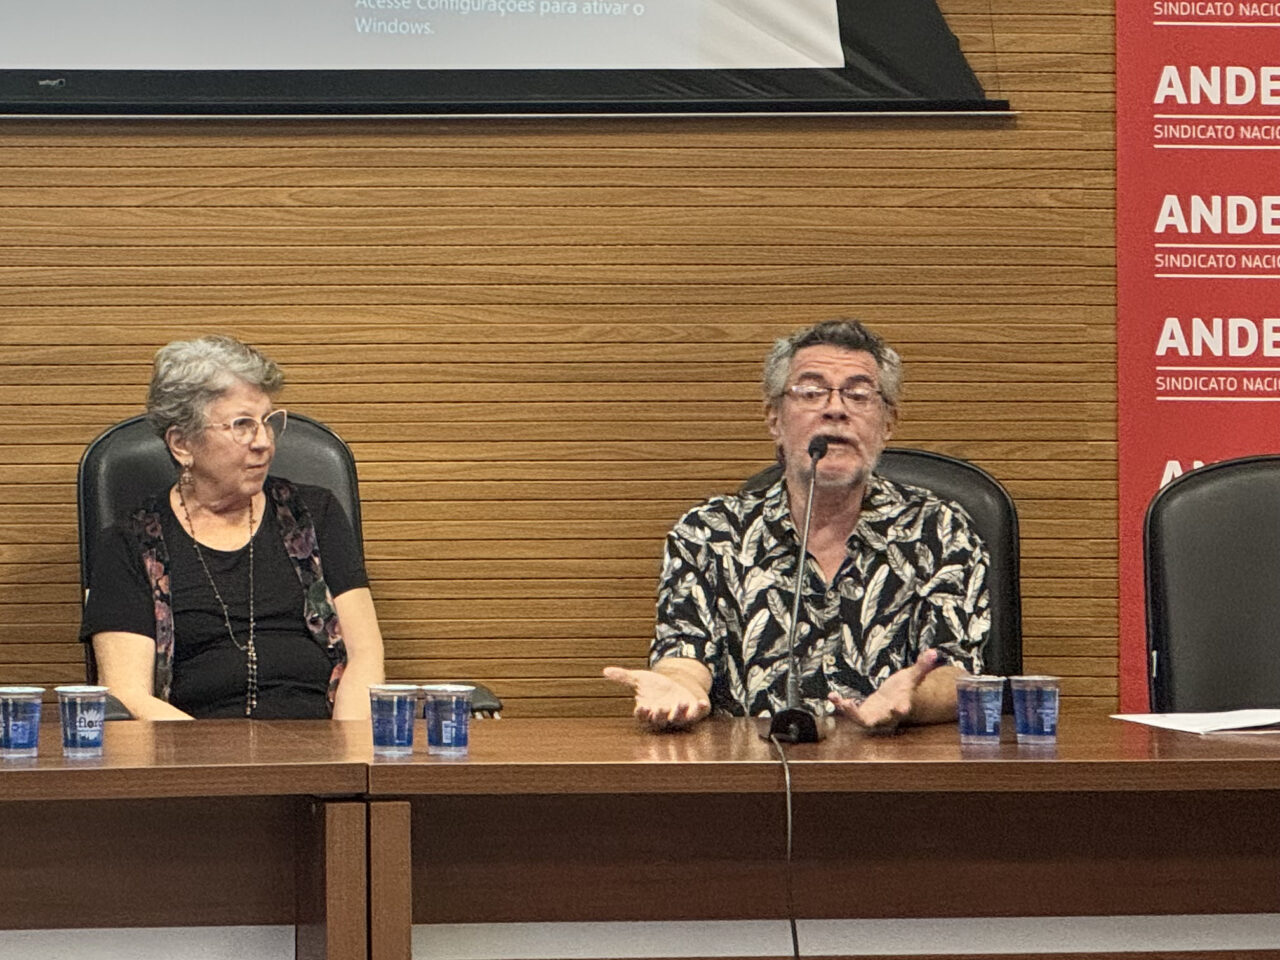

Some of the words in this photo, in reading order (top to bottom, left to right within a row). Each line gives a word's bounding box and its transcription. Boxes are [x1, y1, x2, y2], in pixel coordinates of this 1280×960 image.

[540, 0, 577, 17] para
[633, 3, 645, 16] o
[355, 18, 434, 34] Windows.
[1154, 124, 1234, 139] SINDICATO
[1157, 376, 1237, 391] SINDICATO
